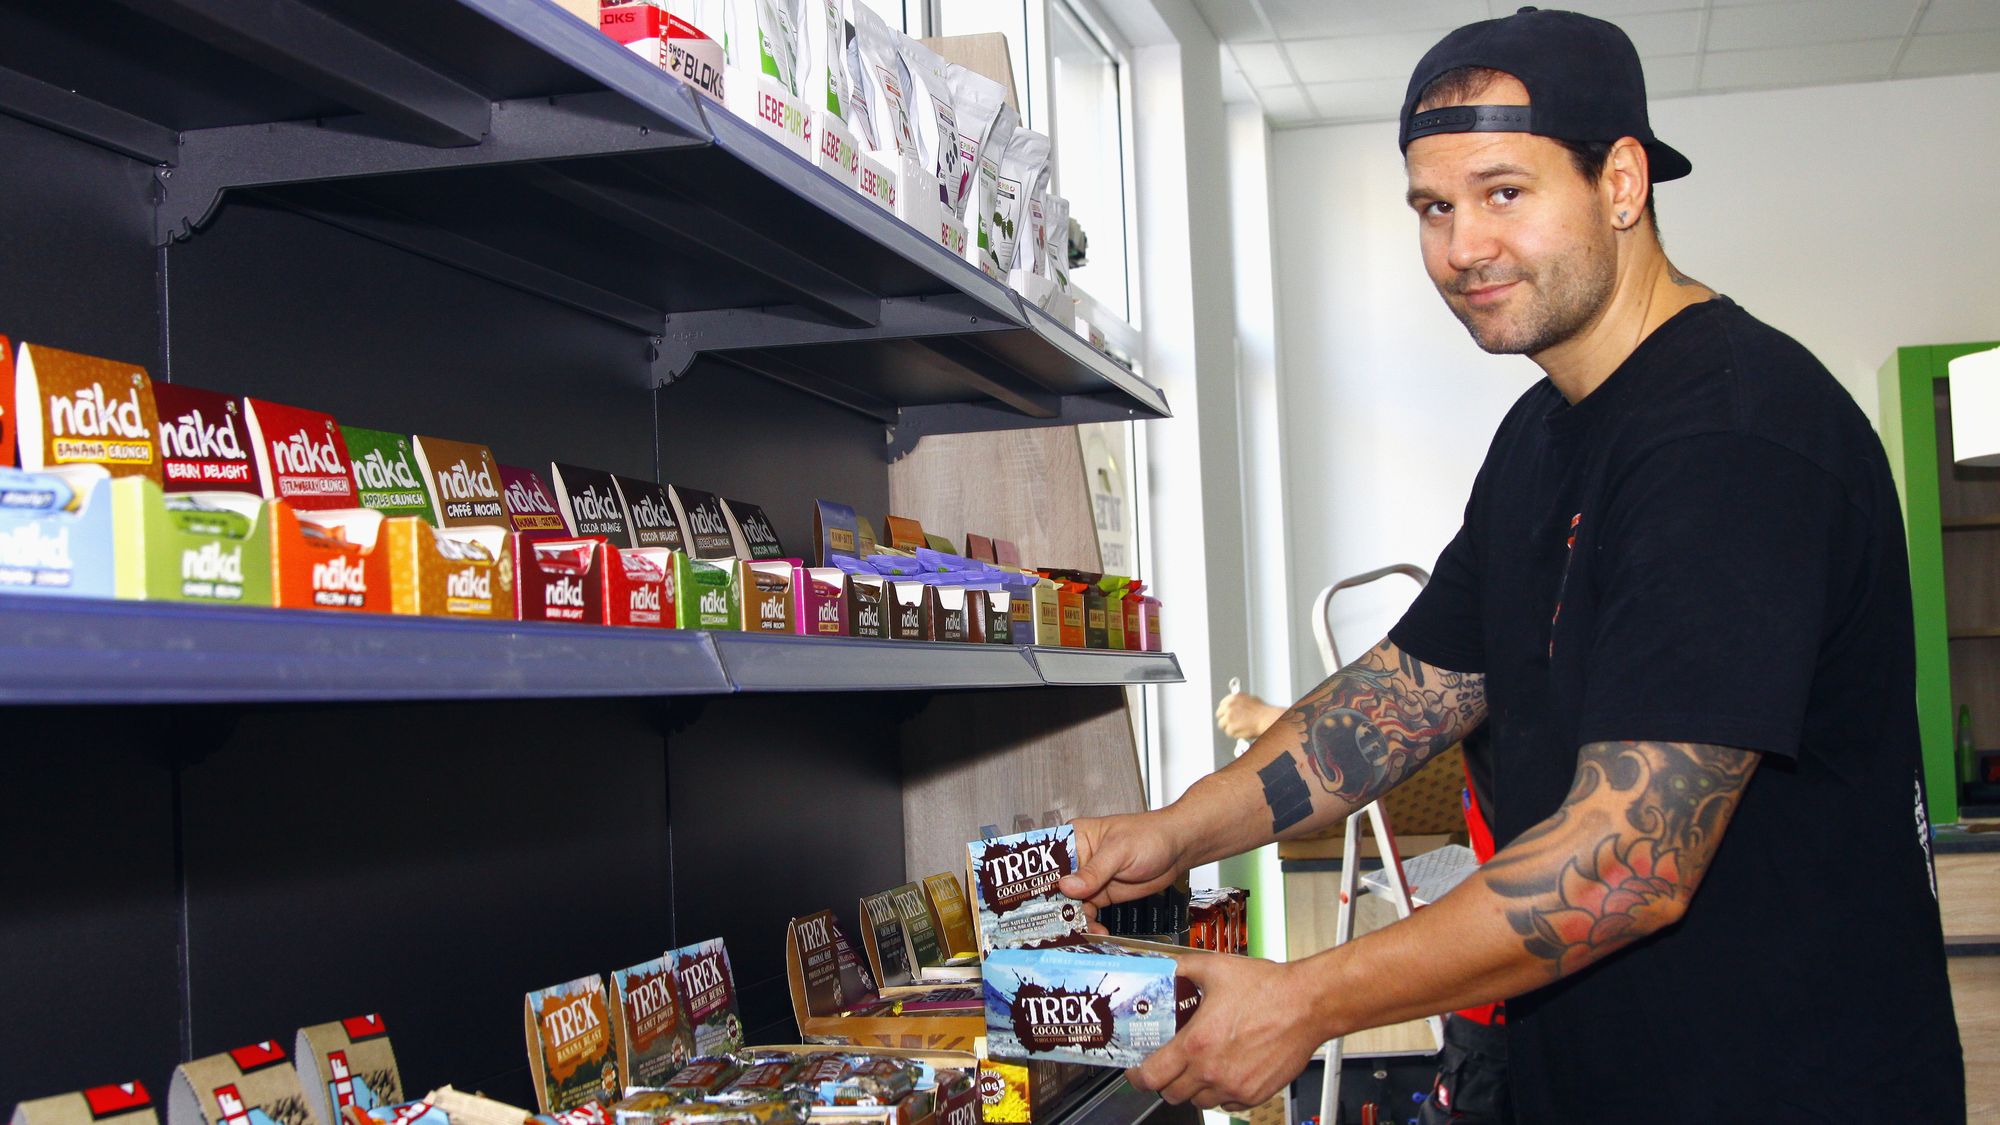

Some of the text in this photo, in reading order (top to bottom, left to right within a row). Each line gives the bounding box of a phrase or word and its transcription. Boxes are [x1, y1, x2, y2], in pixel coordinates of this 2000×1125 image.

[669, 43, 685, 59] SHOT
[684, 52, 725, 100] BLOKS
[758, 90, 802, 137] LEBEPUR
[821, 128, 851, 171] LEBEPUR
[860, 166, 888, 202] LEBEPUR
[942, 223, 958, 250] BEPUR
[57, 442, 149, 460] BANANA CRUNCH
[167, 463, 248, 480] BERRY DELIGHT
[320, 478, 348, 495] CRUNCH
[364, 493, 424, 507] APPLE CRUNCH
[447, 502, 502, 517] CAFFÉ MOCHA
[580, 521, 622, 534] COCOA ORANGE
[640, 530, 678, 542] COCOA DELIGHT
[752, 545, 780, 555] COCOA MINT
[986, 841, 1060, 887] TREK
[931, 878, 959, 901] TREK
[996, 871, 1061, 899] COCOA CHAOS
[1030, 884, 1051, 897] ENERGY
[868, 895, 897, 925] TREK
[895, 889, 927, 919] TREK
[798, 916, 831, 952] TREK
[681, 954, 723, 999] TREK
[628, 972, 672, 1022] TREK
[691, 984, 726, 1011] BERRY BURST
[1021, 995, 1101, 1025] TREK
[1179, 996, 1198, 1011] NEW
[546, 993, 600, 1048] TREK
[657, 1006, 674, 1022] POWER
[1032, 1024, 1102, 1035] COCOA CHAOS
[557, 1029, 602, 1062] BANANA BLAST
